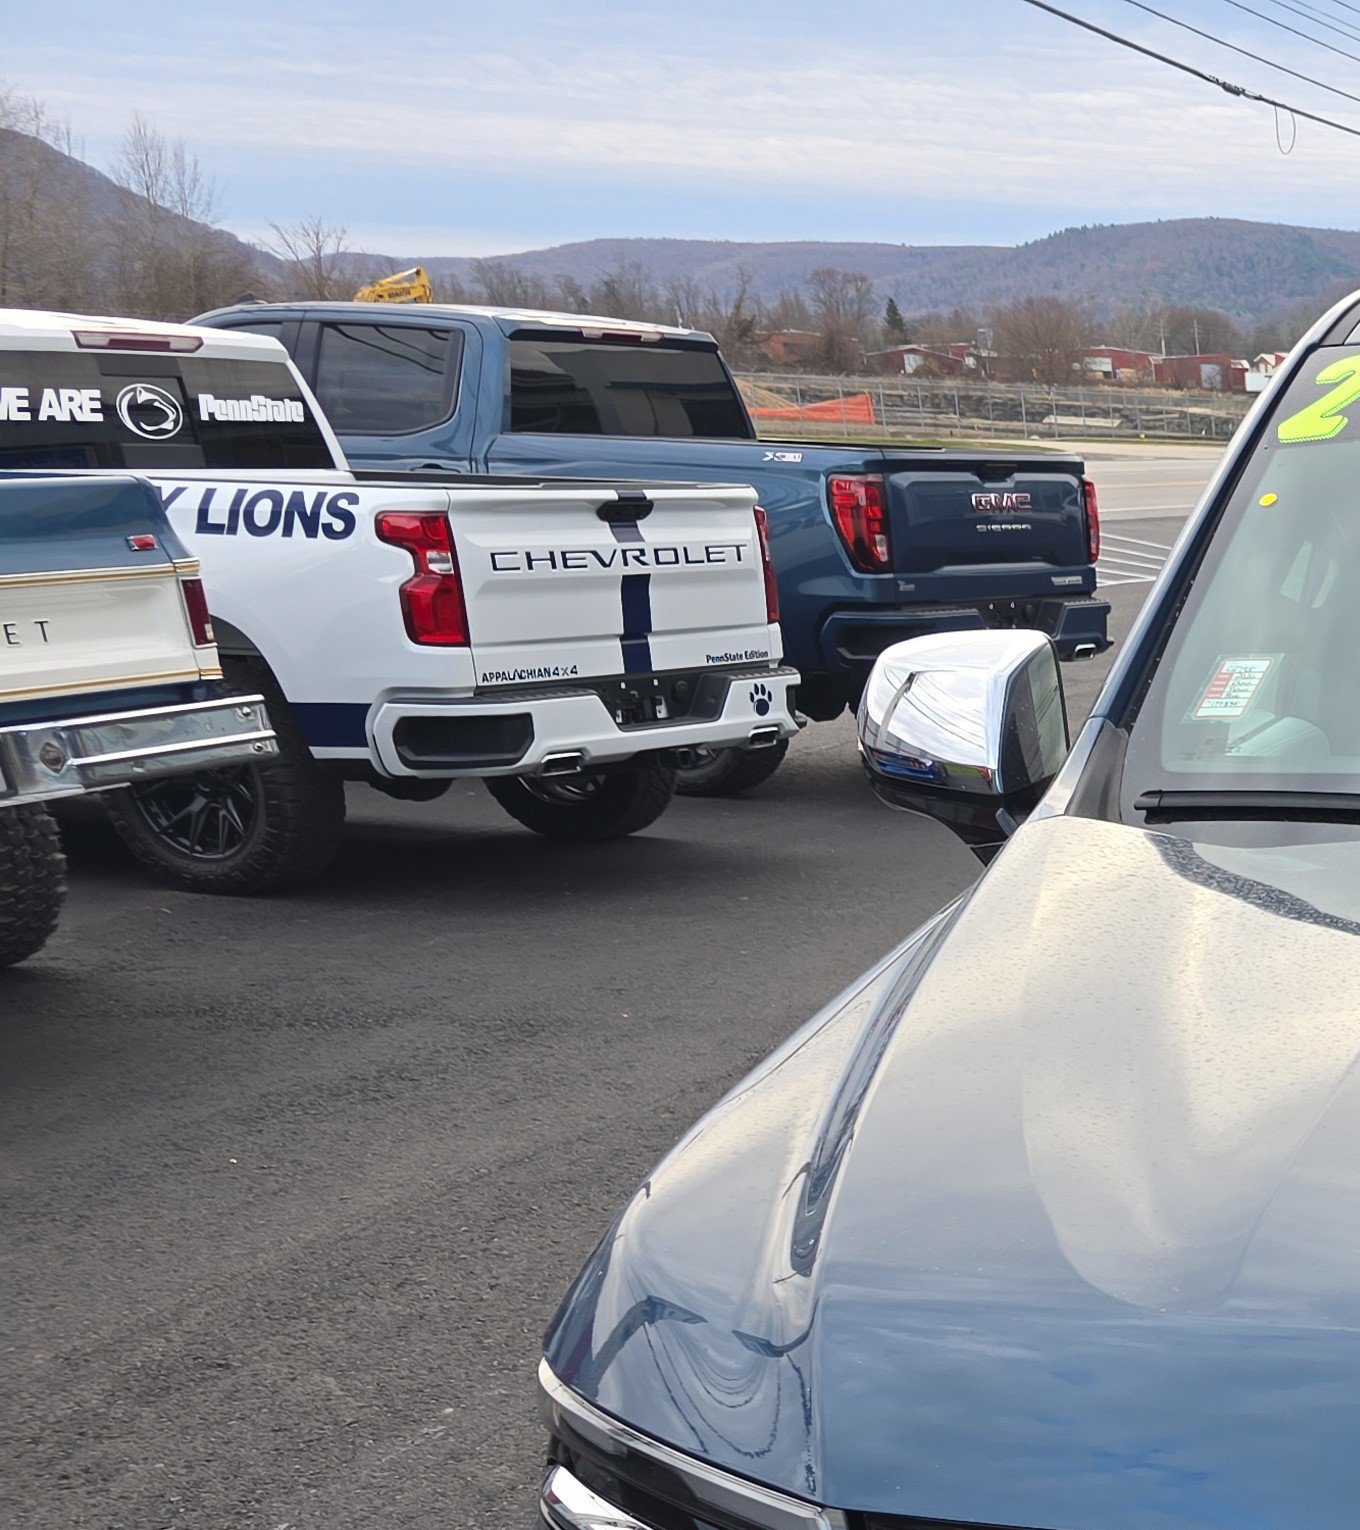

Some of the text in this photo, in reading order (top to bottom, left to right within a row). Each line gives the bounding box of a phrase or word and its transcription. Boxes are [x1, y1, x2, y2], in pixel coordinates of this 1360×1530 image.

[38, 388, 104, 422] ARE
[198, 393, 305, 423] PennState
[195, 487, 360, 540] LIONS
[971, 493, 1032, 512] GMC
[490, 544, 748, 572] CHEVROLET
[744, 649, 768, 660] Edition
[482, 667, 551, 683] APPALACHIAN
